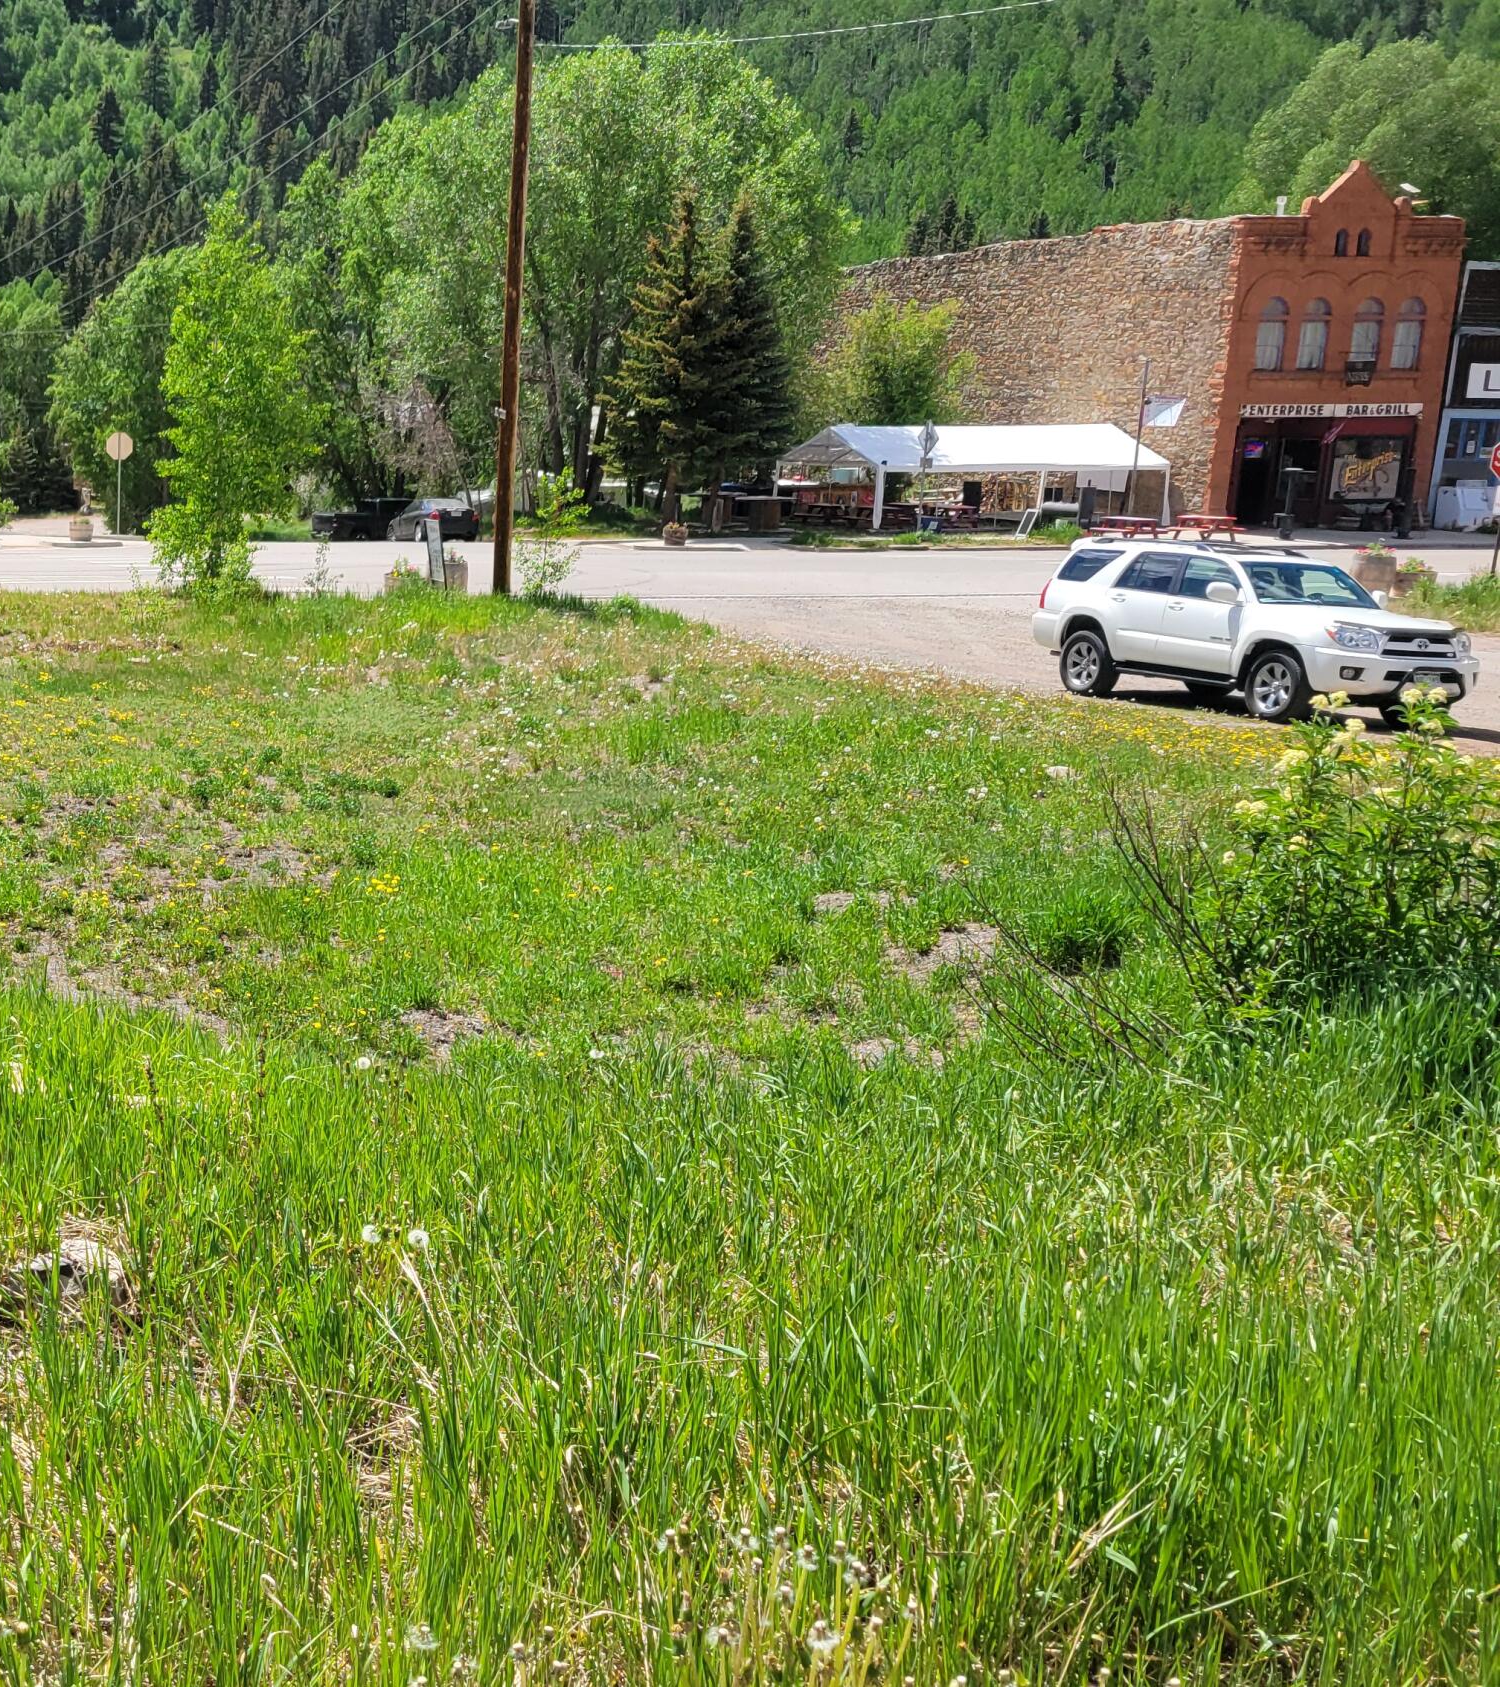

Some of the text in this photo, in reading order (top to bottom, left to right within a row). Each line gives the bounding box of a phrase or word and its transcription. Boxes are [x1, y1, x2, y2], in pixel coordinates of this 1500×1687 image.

[1249, 404, 1325, 416] ENTERPRISE
[1346, 404, 1369, 416] BAR
[1376, 404, 1410, 415] GRILL
